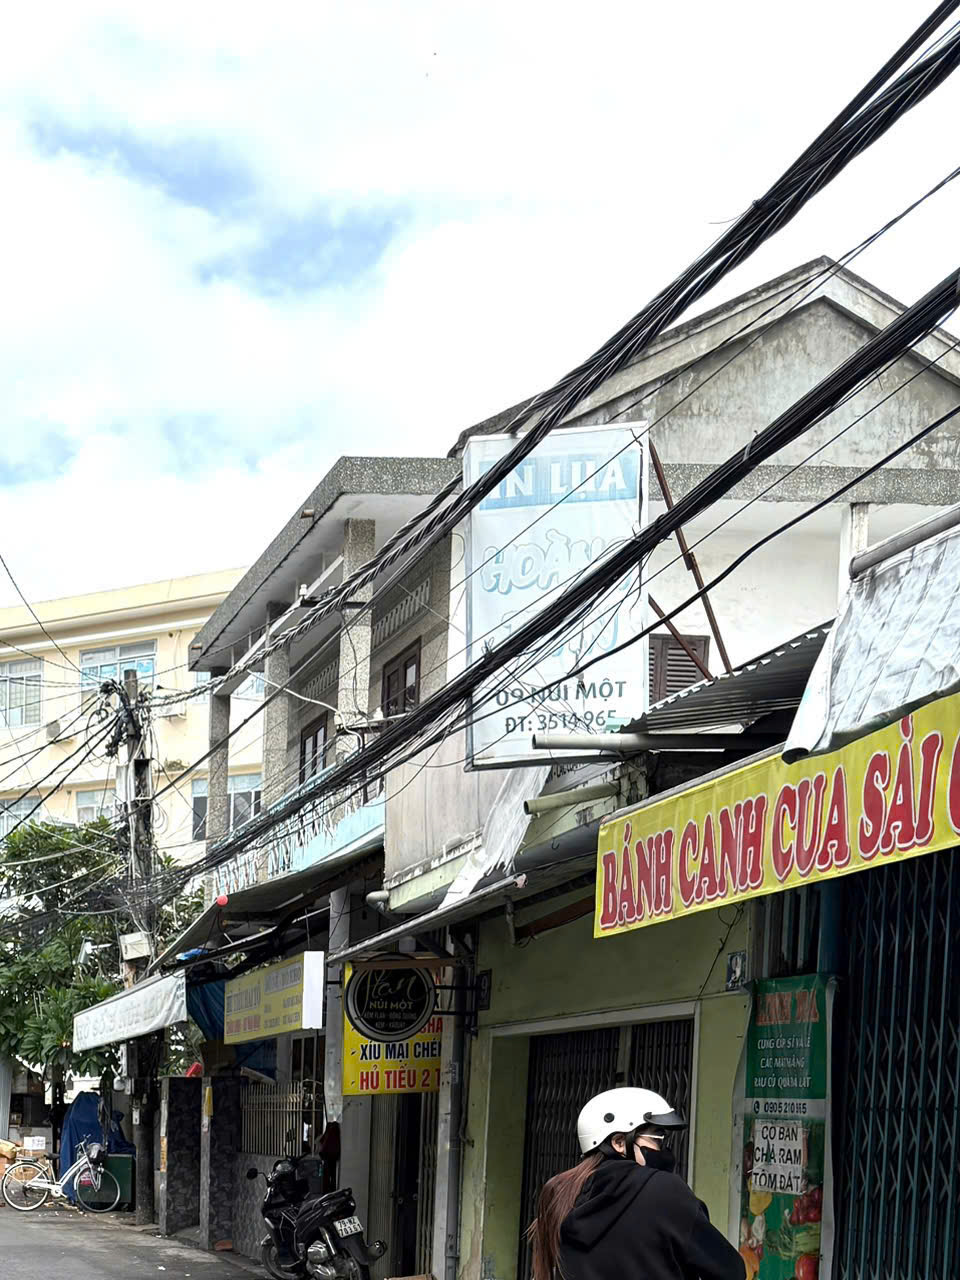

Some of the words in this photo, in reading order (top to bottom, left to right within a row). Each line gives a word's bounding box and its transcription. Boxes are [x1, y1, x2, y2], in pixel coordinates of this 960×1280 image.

[551, 459, 627, 499] LỤA
[576, 678, 627, 702] MỘT
[505, 716, 532, 733] ĐT:
[600, 820, 675, 930] BÁNH
[678, 793, 769, 907] CANH
[771, 764, 852, 884] CUA
[360, 1041, 381, 1060] XÍU
[385, 1042, 409, 1062] MẠI
[360, 1064, 380, 1090] HỦ
[384, 1063, 417, 1089] TIẾU
[422, 1069, 431, 1088] 2
[779, 1148, 802, 1166] RAM
[753, 1169, 777, 1191] TÔM
